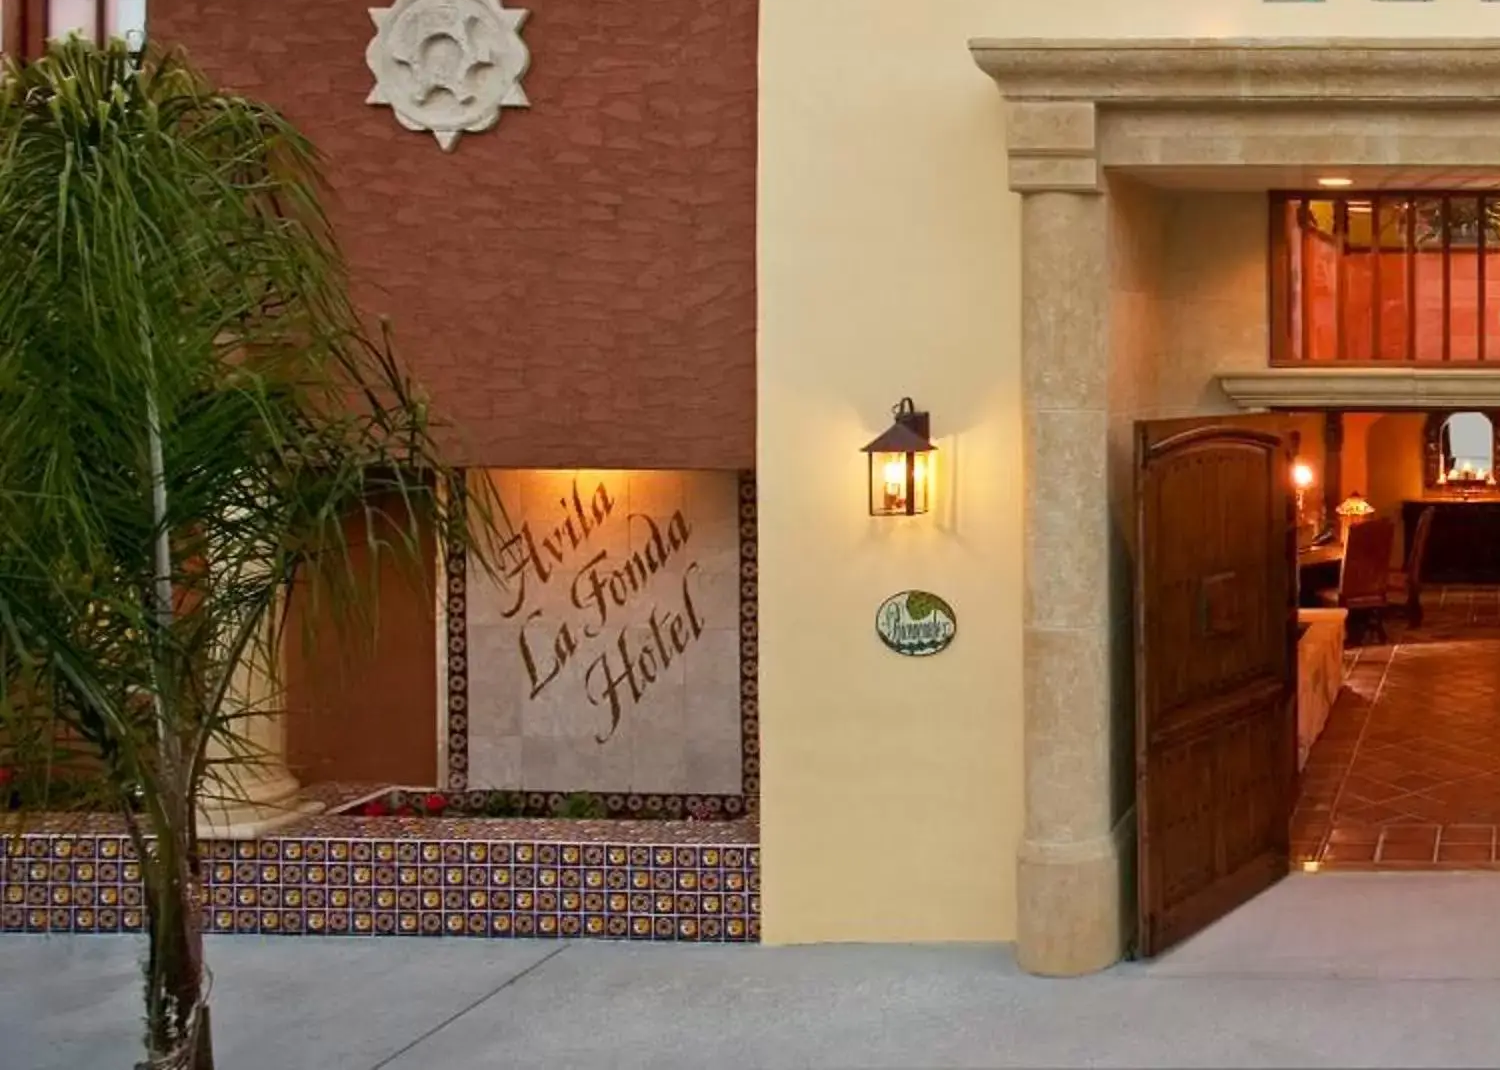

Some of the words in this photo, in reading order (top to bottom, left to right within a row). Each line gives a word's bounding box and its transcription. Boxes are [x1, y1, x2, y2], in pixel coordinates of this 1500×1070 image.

[500, 477, 615, 618] Avila
[518, 610, 579, 699] La
[571, 509, 693, 638] Fonda
[585, 561, 706, 744] Hotel
